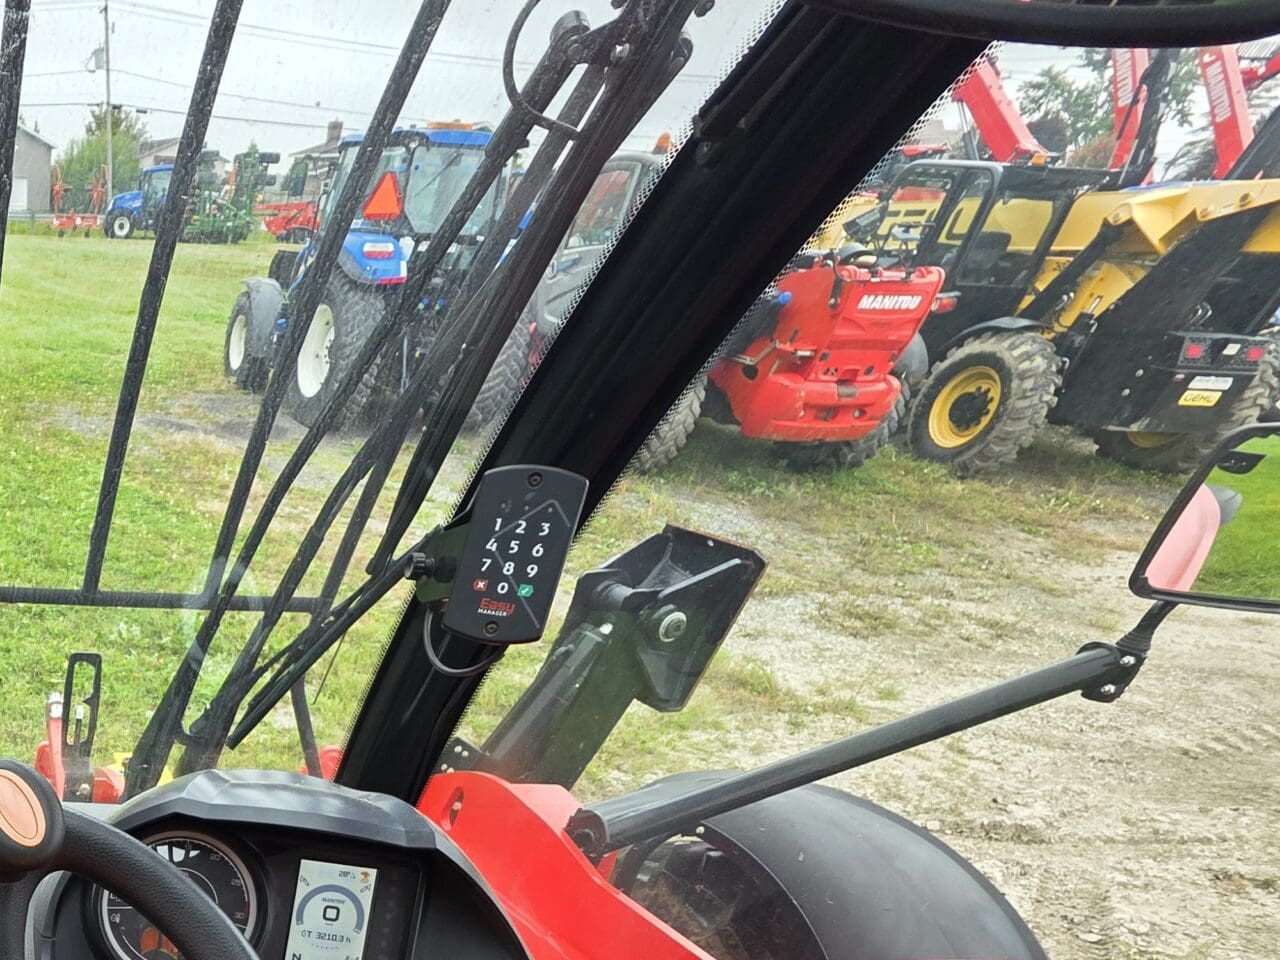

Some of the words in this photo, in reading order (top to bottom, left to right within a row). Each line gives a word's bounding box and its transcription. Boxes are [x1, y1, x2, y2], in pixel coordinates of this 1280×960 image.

[1116, 48, 1133, 107] ANITOU
[1206, 61, 1231, 122] MANITOU
[857, 294, 922, 310] MANITOU
[494, 518, 503, 532] 1
[515, 520, 527, 534] 2
[538, 522, 550, 536] 3
[486, 537, 497, 551] 4
[509, 540, 521, 553] 5
[532, 543, 544, 557] 6
[480, 558, 492, 572] 7
[502, 561, 515, 575] 8
[526, 564, 538, 578] 9
[497, 582, 509, 594] 0
[477, 608, 507, 617] MANAGER
[480, 597, 516, 616] Easy
[323, 905, 340, 922] 0
